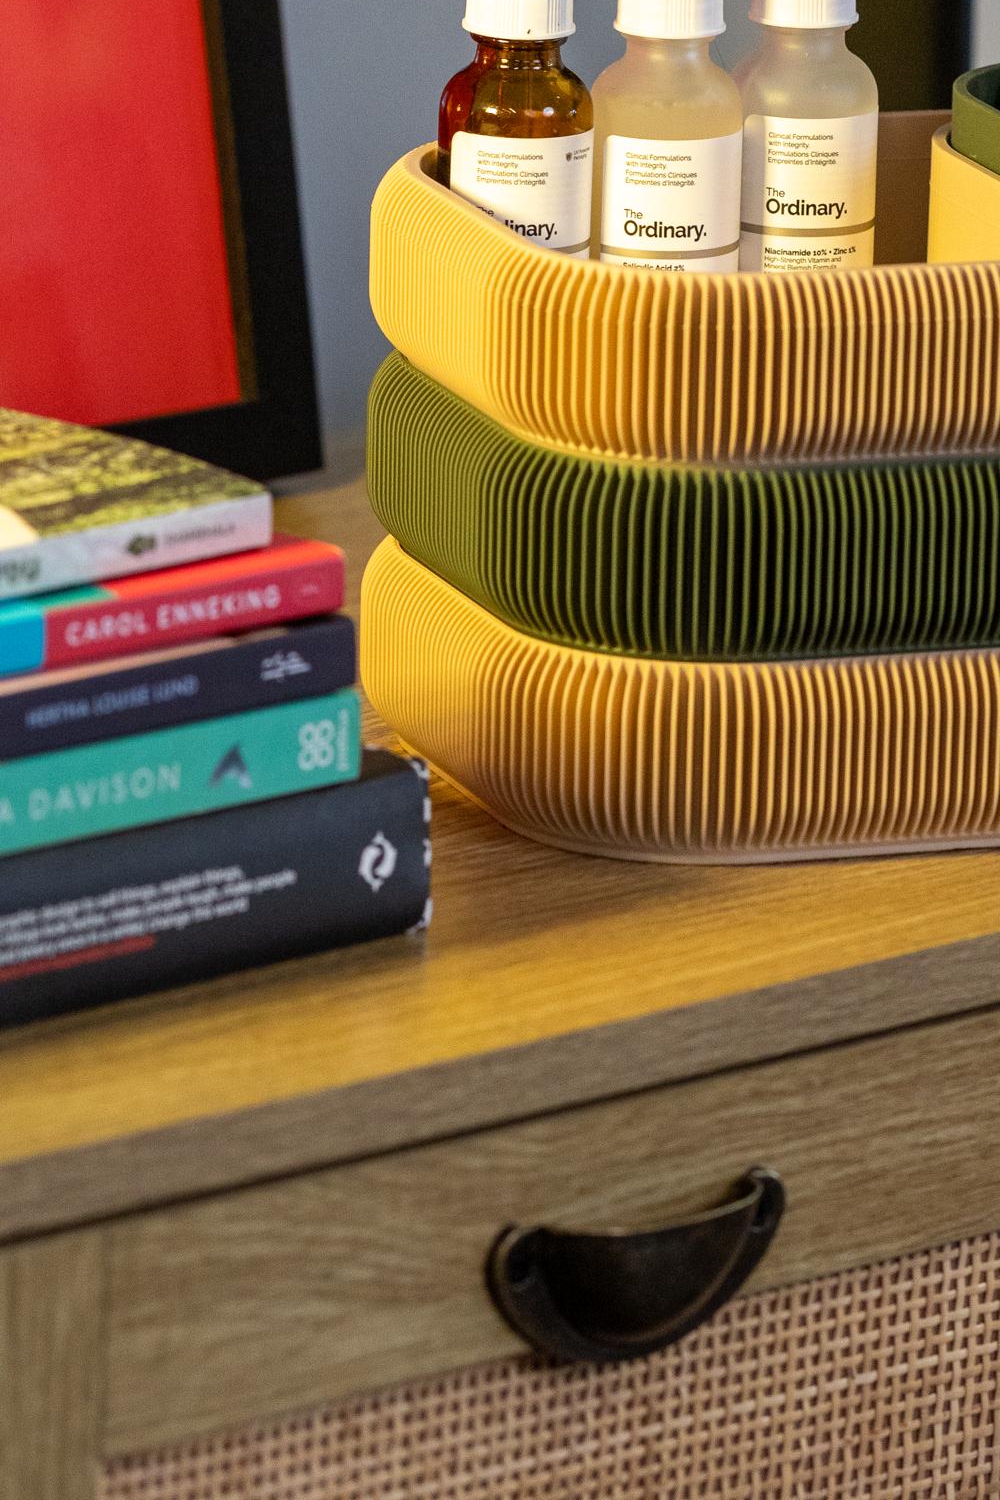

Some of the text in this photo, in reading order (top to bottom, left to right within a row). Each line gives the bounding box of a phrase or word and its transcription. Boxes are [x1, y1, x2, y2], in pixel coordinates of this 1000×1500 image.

[768, 149, 839, 159] Formulations Cliniques
[477, 168, 549, 179] Formulations Cliniques
[625, 169, 667, 178] Formulations
[766, 187, 786, 198] The
[624, 208, 643, 219] The
[766, 198, 847, 219] Ordinary.
[624, 220, 707, 242] Ordinary.
[764, 247, 811, 256] Niacinamide
[65, 584, 282, 646] CAROL ENNEKING
[29, 762, 181, 821] DAVISON
